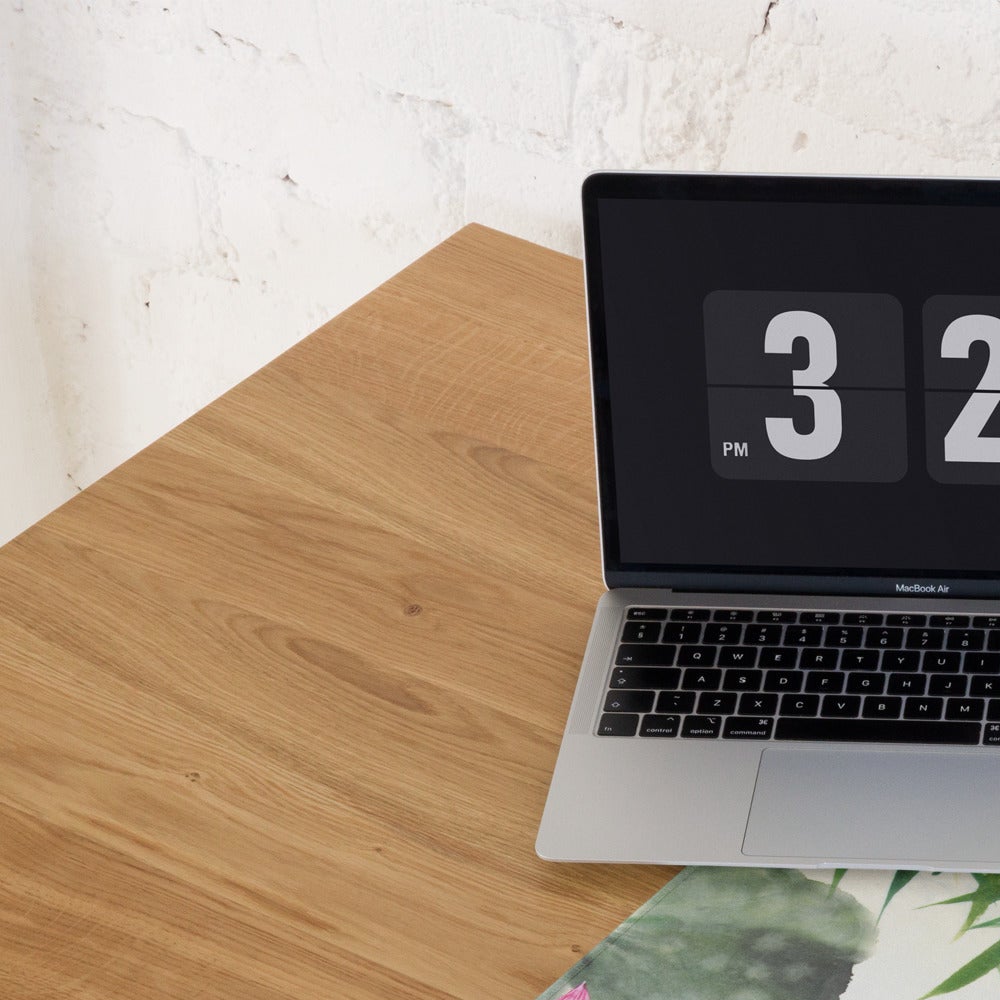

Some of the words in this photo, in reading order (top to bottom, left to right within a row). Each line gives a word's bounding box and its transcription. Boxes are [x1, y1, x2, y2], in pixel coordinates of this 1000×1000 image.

[764, 310, 843, 461] 3
[722, 441, 749, 457] PM
[895, 583, 936, 593] MacBook
[937, 584, 950, 593] Air
